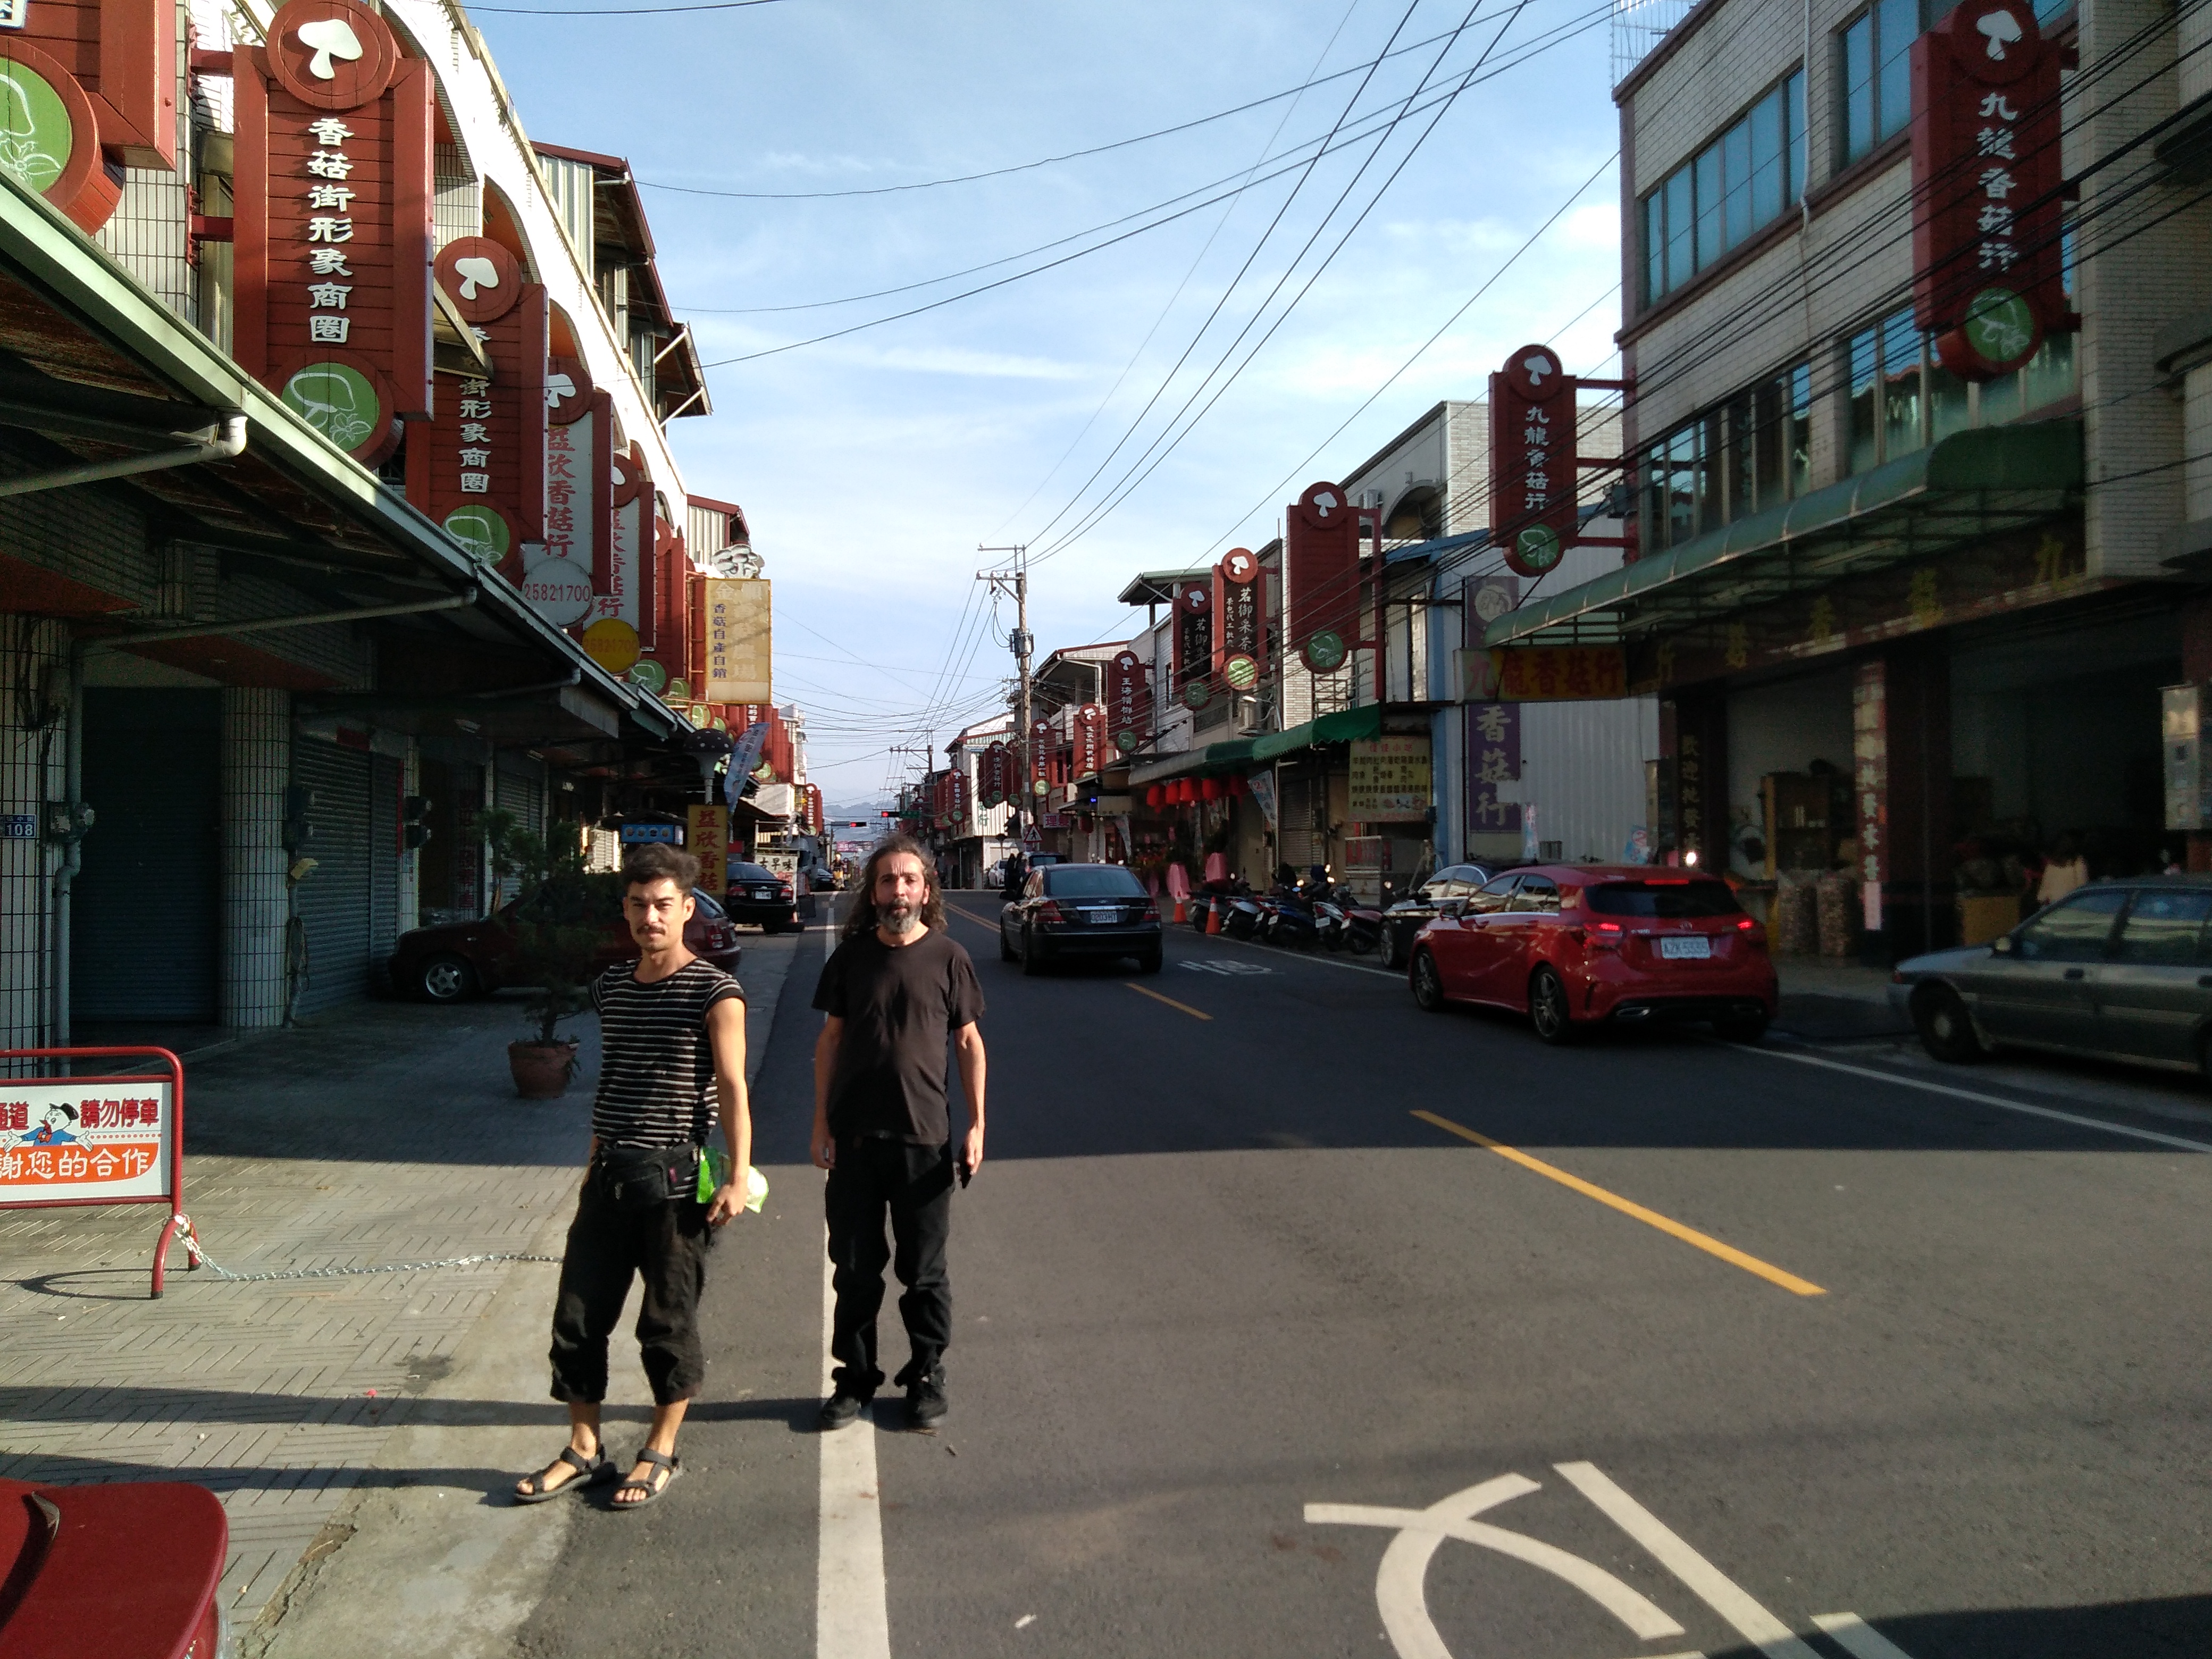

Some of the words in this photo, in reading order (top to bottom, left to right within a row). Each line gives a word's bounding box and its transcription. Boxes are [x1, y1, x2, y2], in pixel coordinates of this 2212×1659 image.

[1977, 92, 2018, 273] 九龍香菇行
[307, 118, 355, 343] 香菇街形象商圈
[458, 326, 492, 493] 街形象商圈
[1524, 406, 1550, 510] 九龍香菇行
[524, 583, 591, 602] 25821700
[713, 604, 727, 678] 香菇自產自銷
[1474, 706, 1512, 826] 香菇行
[6, 824, 33, 836] 108
[759, 857, 793, 871] 古早味
[80, 1097, 159, 1129] 請勿停車
